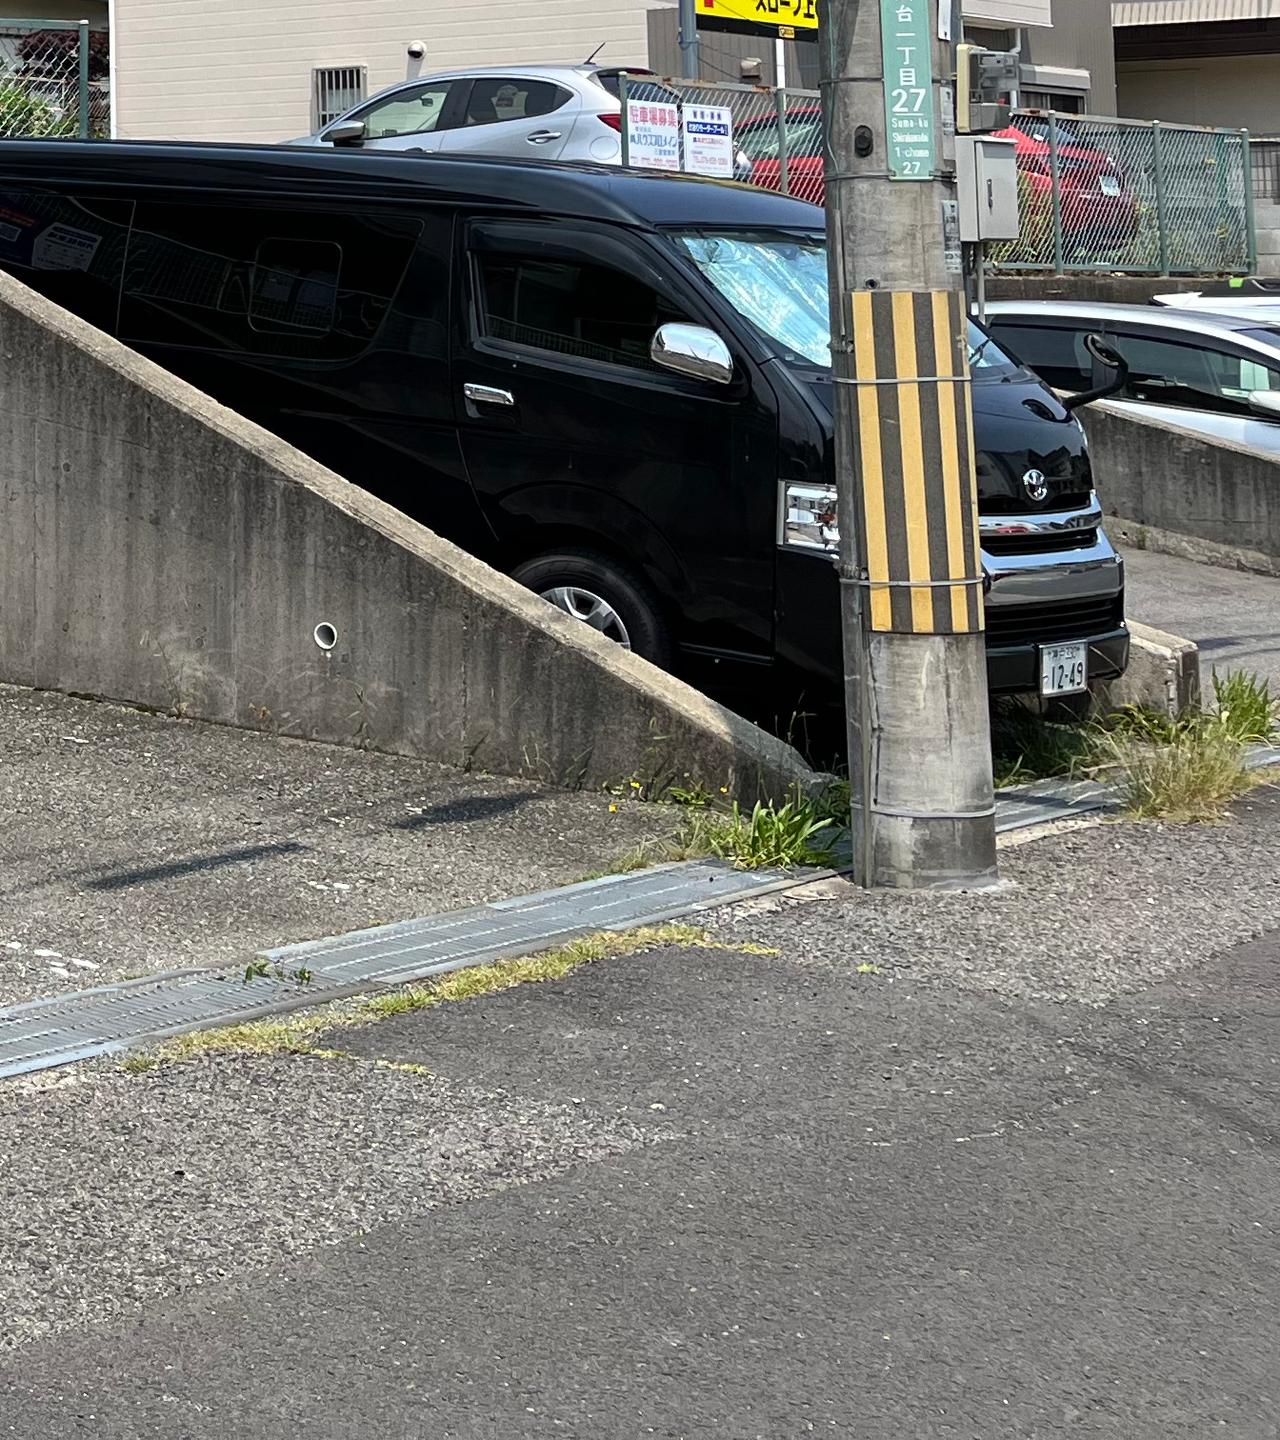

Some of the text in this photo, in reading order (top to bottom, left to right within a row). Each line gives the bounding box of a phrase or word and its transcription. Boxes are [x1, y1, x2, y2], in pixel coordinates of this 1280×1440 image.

[891, 88, 926, 113] 27
[902, 161, 921, 174] 27
[1051, 661, 1083, 691] 12-49
